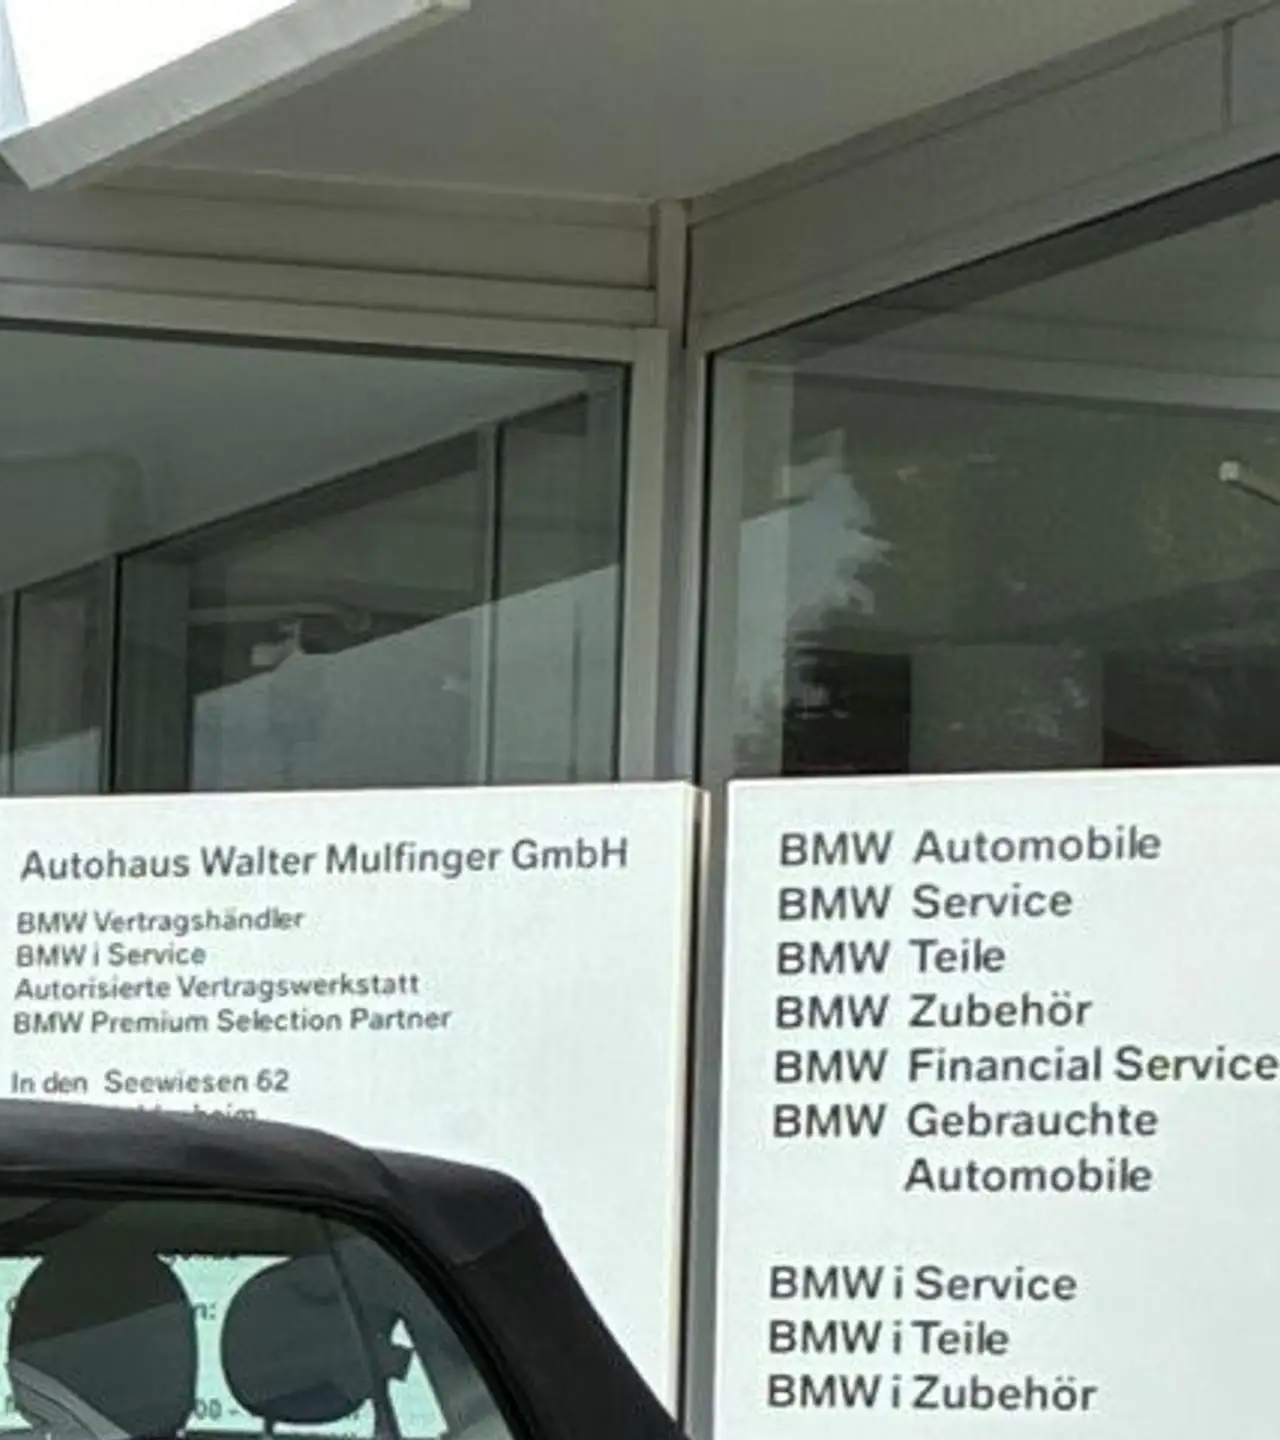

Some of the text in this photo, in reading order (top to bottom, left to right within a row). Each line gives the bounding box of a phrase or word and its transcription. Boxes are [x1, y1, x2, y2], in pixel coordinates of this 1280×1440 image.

[20, 837, 628, 881] Autohaus Walter Mulfinger GmbH
[779, 824, 1162, 867] BMW Automobile
[778, 882, 1073, 922] BMW Service
[16, 907, 305, 938] BMW Vertragshändler
[16, 941, 207, 968] BMW i Service
[777, 937, 1006, 976] BMW Teile
[14, 972, 419, 1004] Autorisierte Vertragswerkstatt
[13, 1007, 452, 1035] BMW Premium Selection Partner
[776, 991, 1093, 1030] BMW Zubehör
[11, 1068, 290, 1095] In den Seewiesen 62
[775, 1044, 1280, 1084] BMW Financial Service
[773, 1101, 1159, 1138] BMW Gebrauchte
[904, 1157, 1153, 1193] Automobile
[769, 1265, 1077, 1301] BMW i Service
[769, 1319, 1010, 1356] BMW i Teile
[767, 1373, 1098, 1412] BMW i Zubehör
